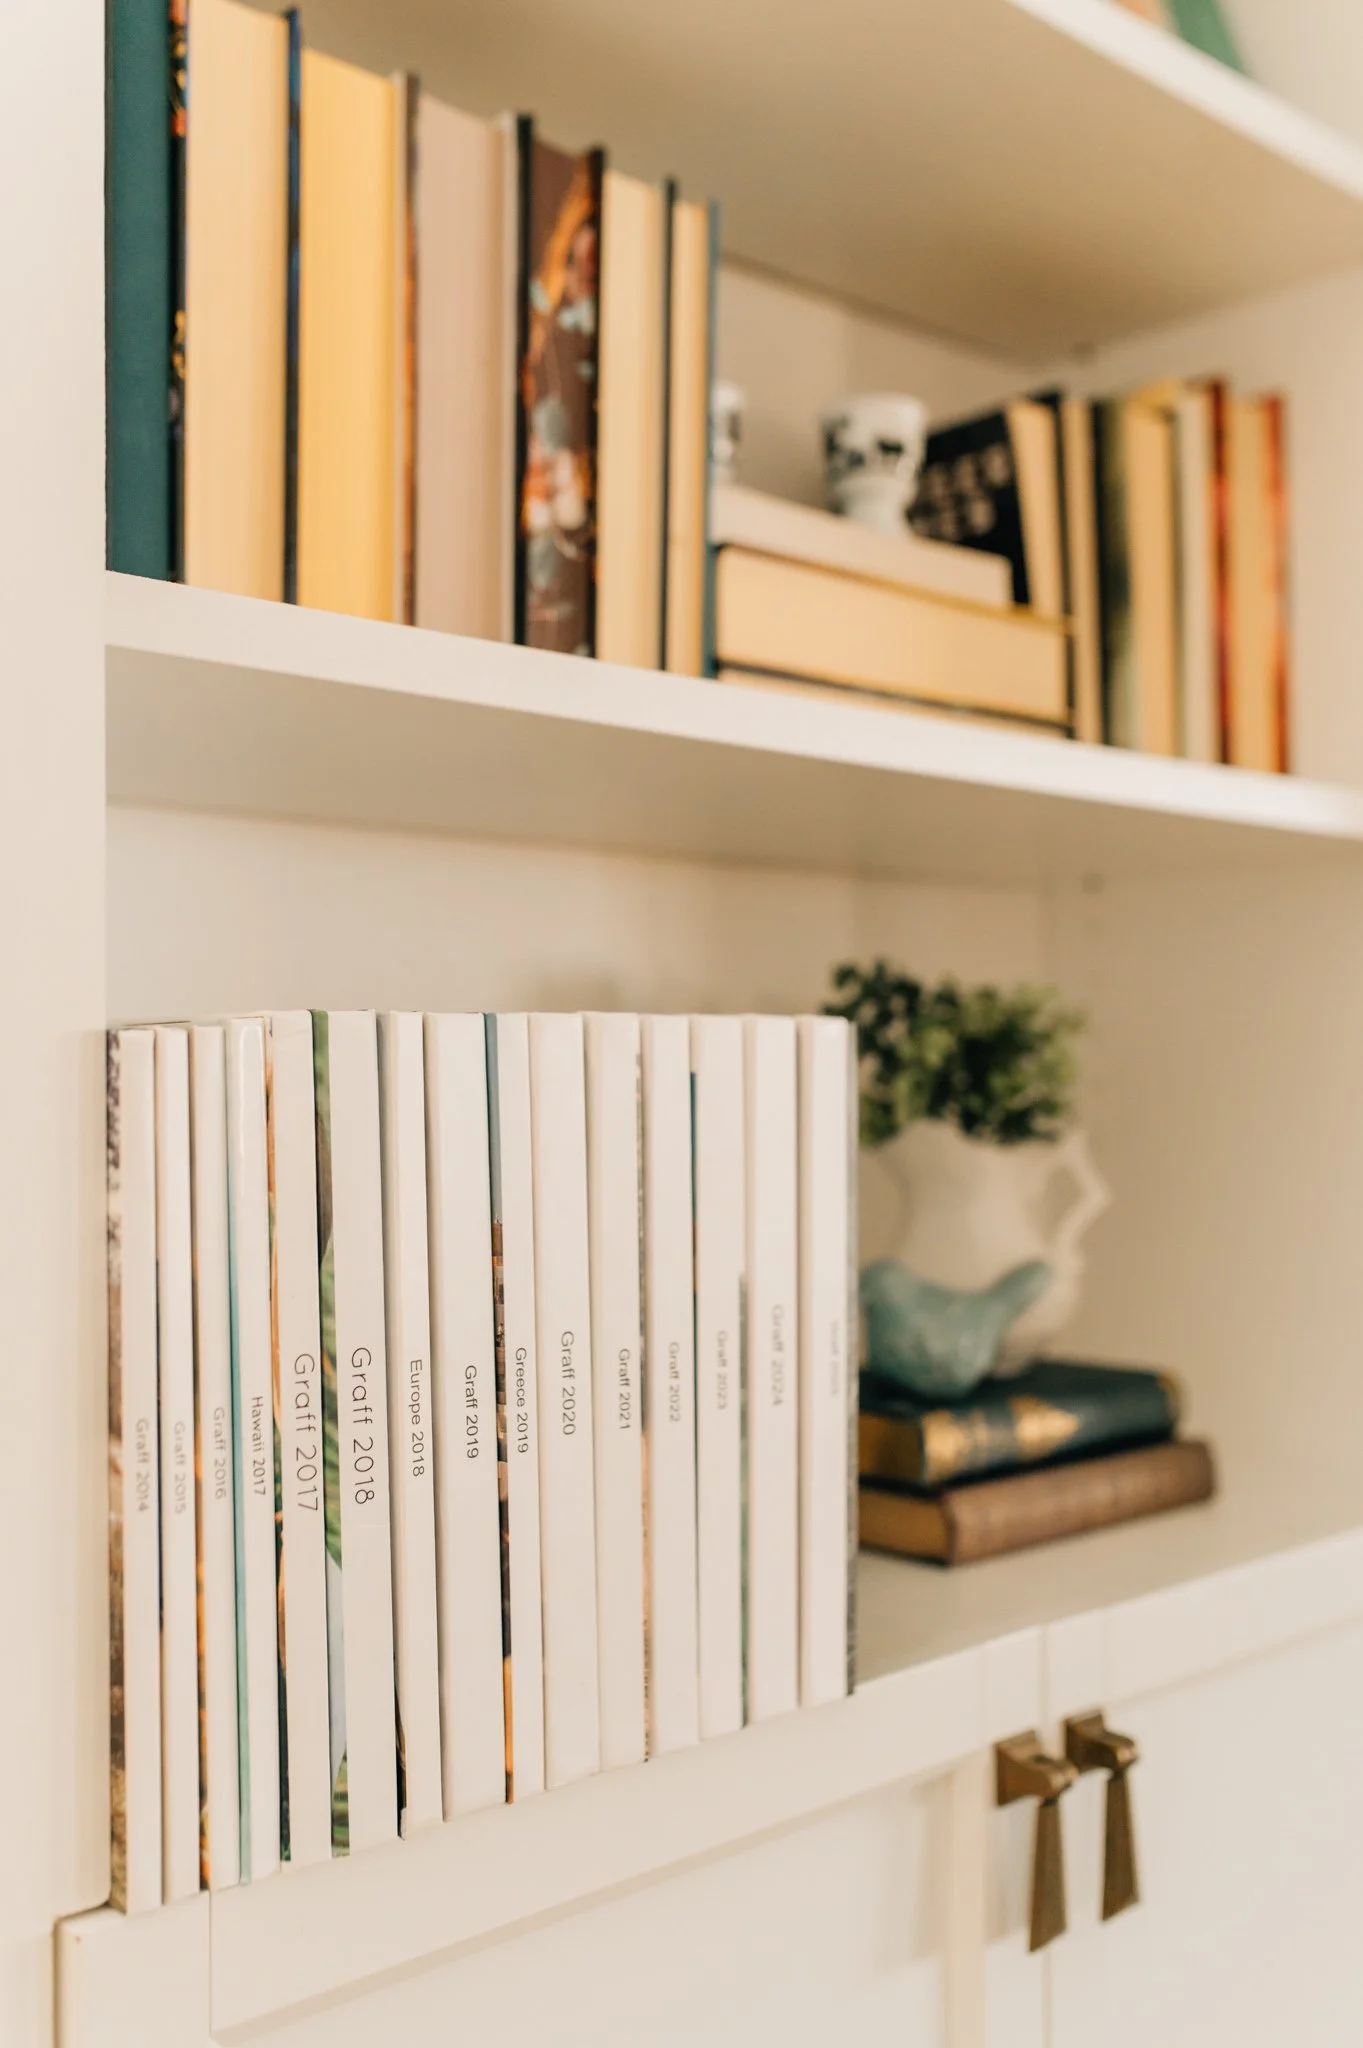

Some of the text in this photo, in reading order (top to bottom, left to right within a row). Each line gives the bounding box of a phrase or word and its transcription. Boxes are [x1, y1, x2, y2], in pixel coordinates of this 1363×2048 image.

[514, 1347, 530, 1454] Greece 2019
[560, 1330, 577, 1436] Graff 2020
[618, 1348, 631, 1430] Graff 2021
[668, 1341, 680, 1423] Graff 2022
[716, 1330, 729, 1410] Graff 2023
[770, 1304, 785, 1407] Graff 2024
[213, 1406, 227, 1500] Graff 2016
[250, 1396, 267, 1496] Hawaii 2017
[293, 1353, 319, 1512] Graff 2017
[351, 1347, 375, 1505] Graff 2018
[409, 1359, 425, 1478] Europe 2018
[464, 1365, 479, 1459] Graff 2019
[135, 1418, 151, 1512] Graff 2014
[173, 1421, 187, 1514] Graff 2015
